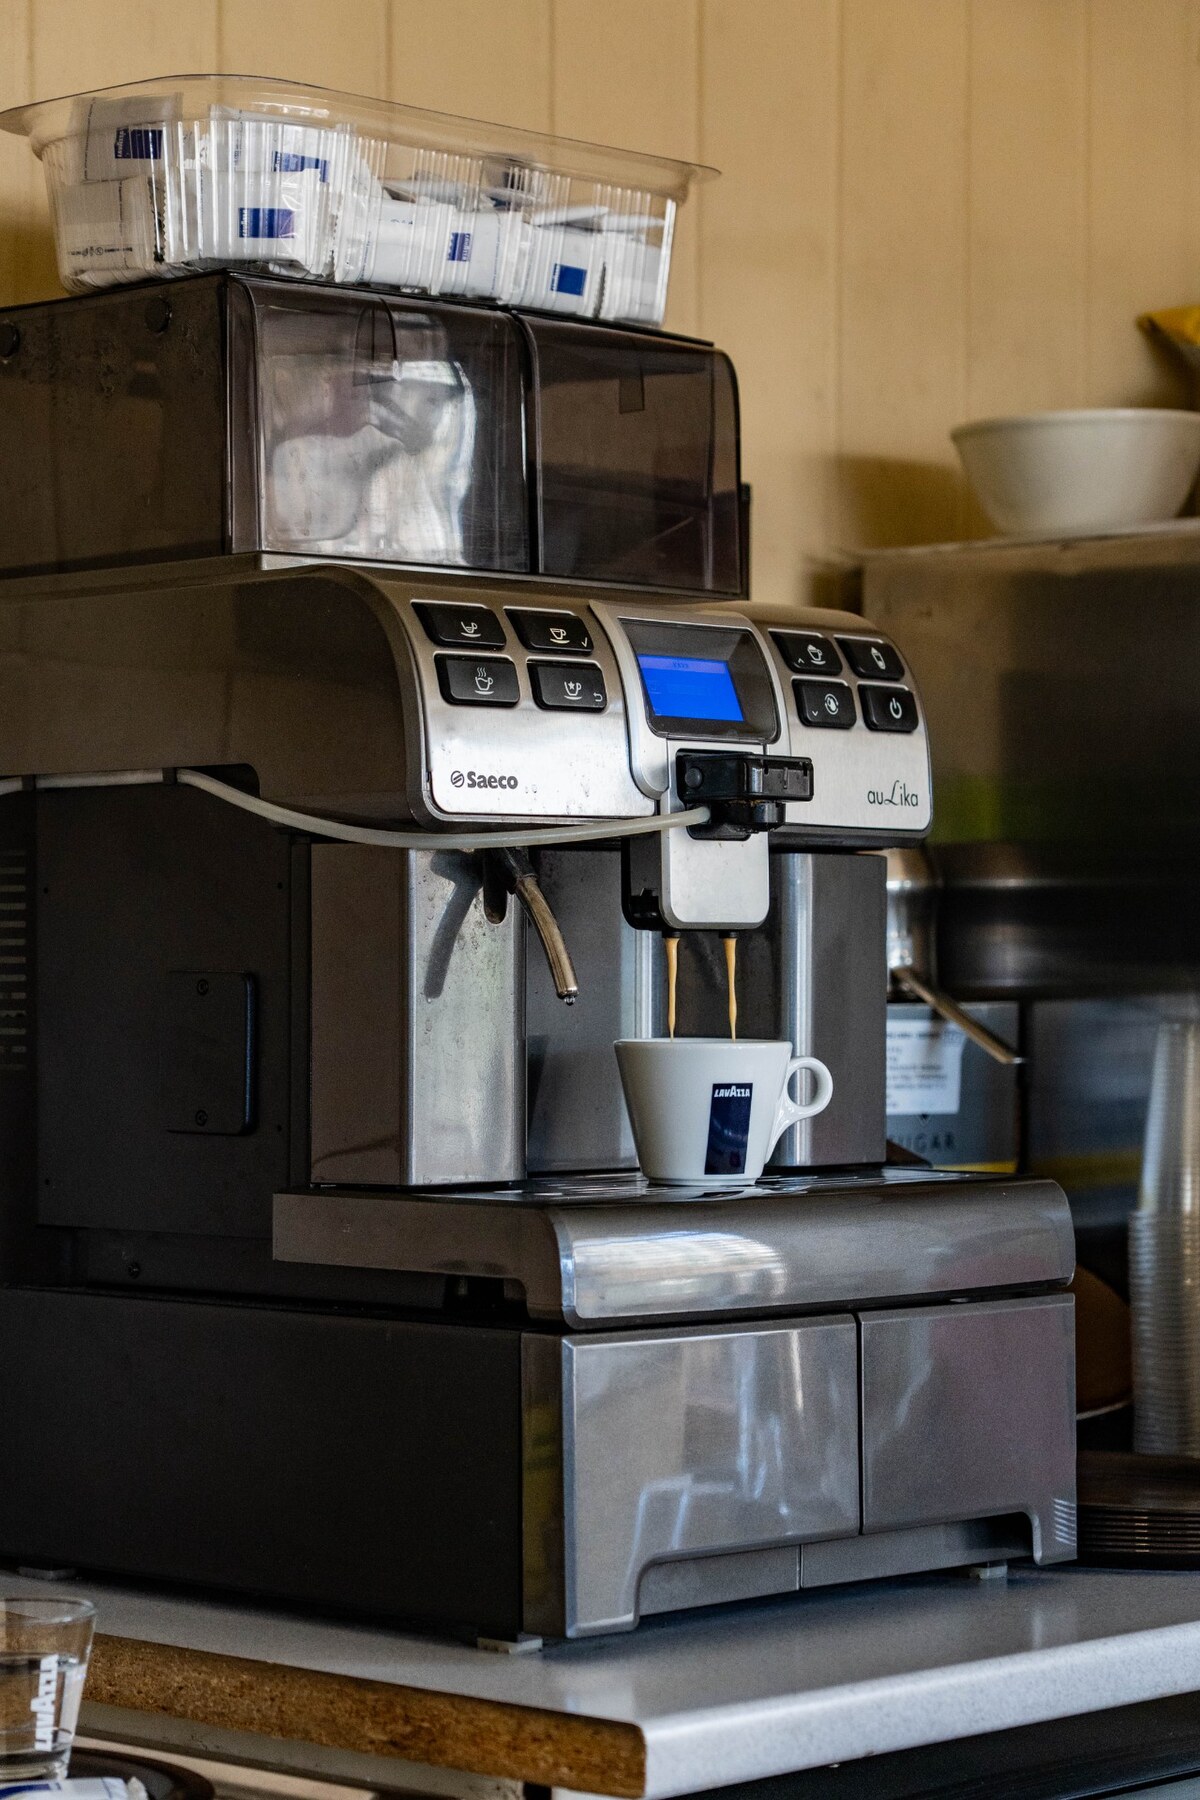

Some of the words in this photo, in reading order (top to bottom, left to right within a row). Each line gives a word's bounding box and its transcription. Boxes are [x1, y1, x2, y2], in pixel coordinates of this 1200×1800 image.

[467, 771, 518, 789] Saeco
[867, 779, 918, 807] auLika
[714, 1085, 750, 1097] LAVAZZA
[30, 1654, 59, 1751] LAVAZZA
